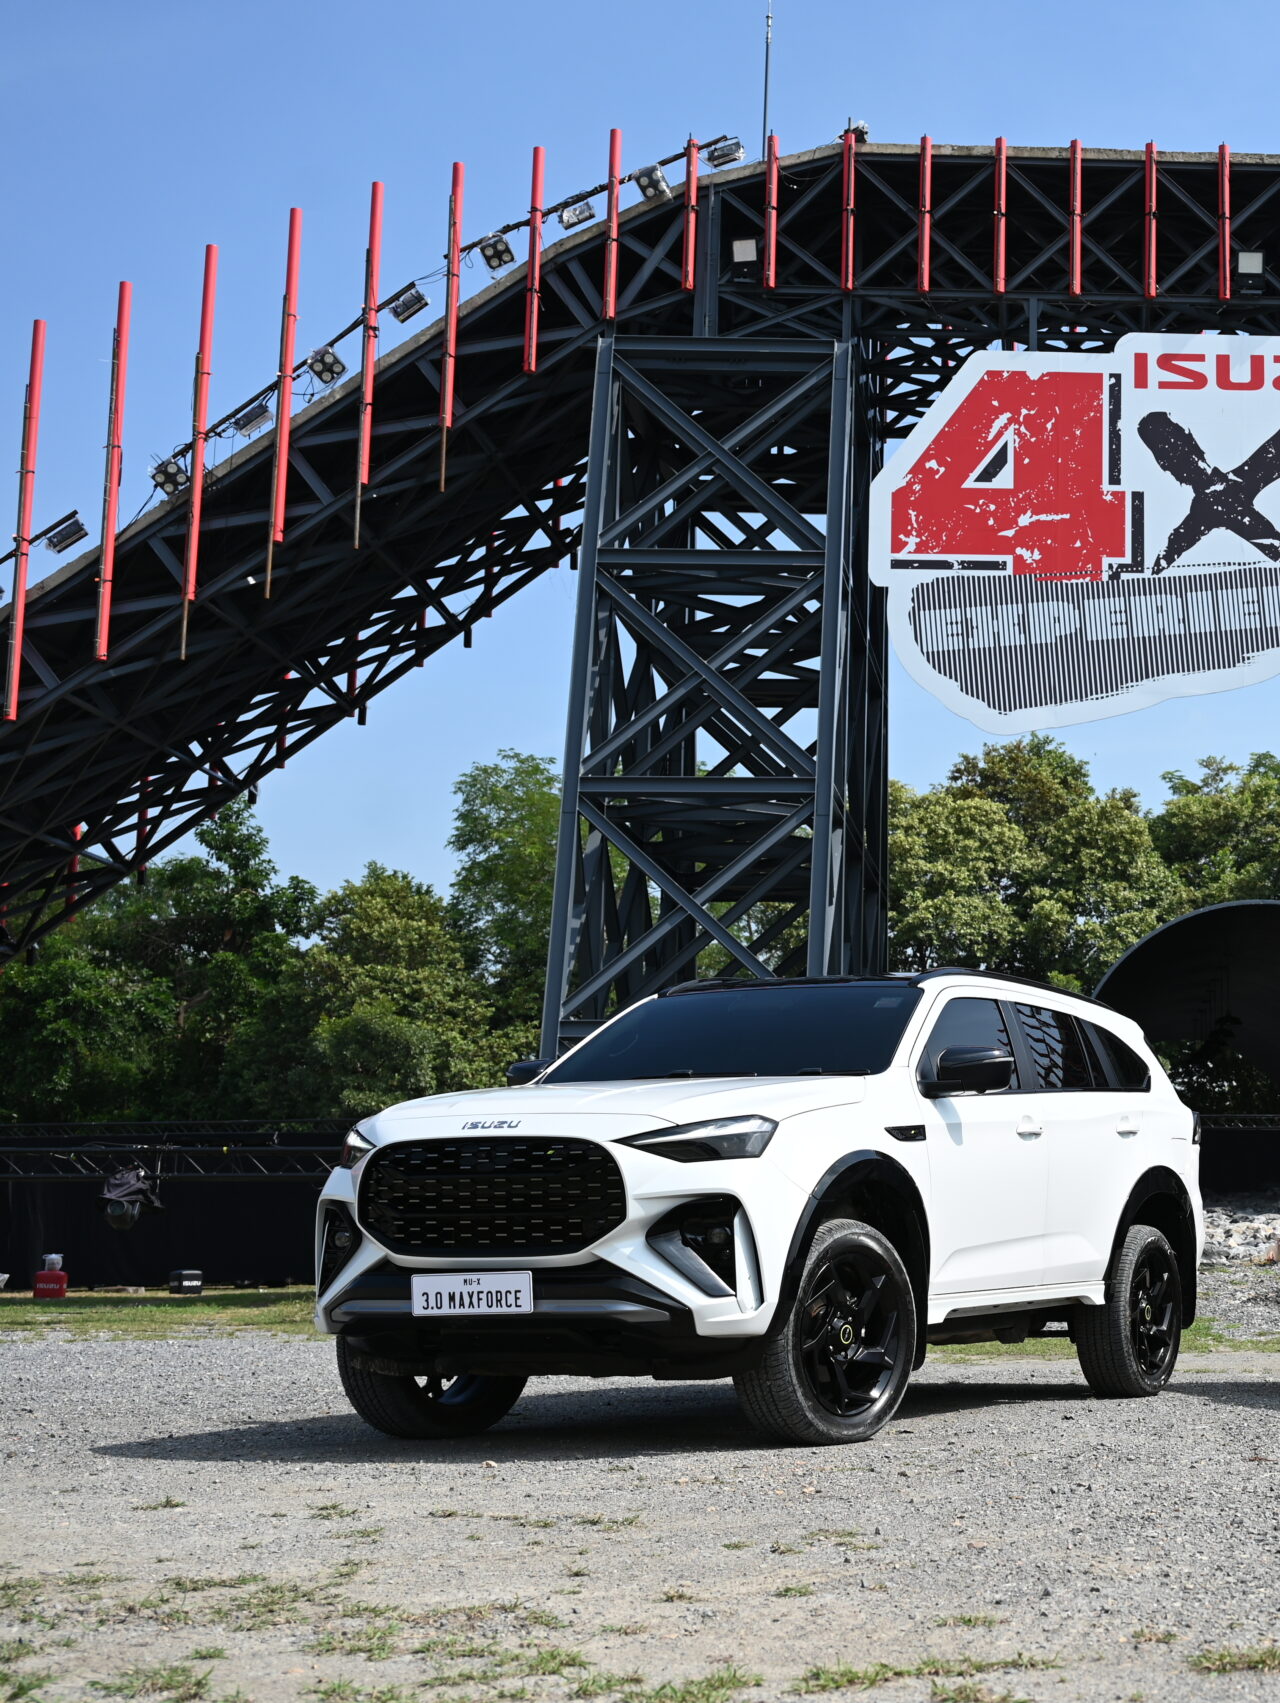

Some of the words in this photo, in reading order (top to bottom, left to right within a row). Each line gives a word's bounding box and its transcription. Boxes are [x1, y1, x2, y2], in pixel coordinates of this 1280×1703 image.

[461, 1120, 522, 1130] ISUZU
[463, 1278, 481, 1286] MU-X
[422, 1291, 443, 1310] 3.0
[448, 1290, 522, 1309] MAXFORCE
